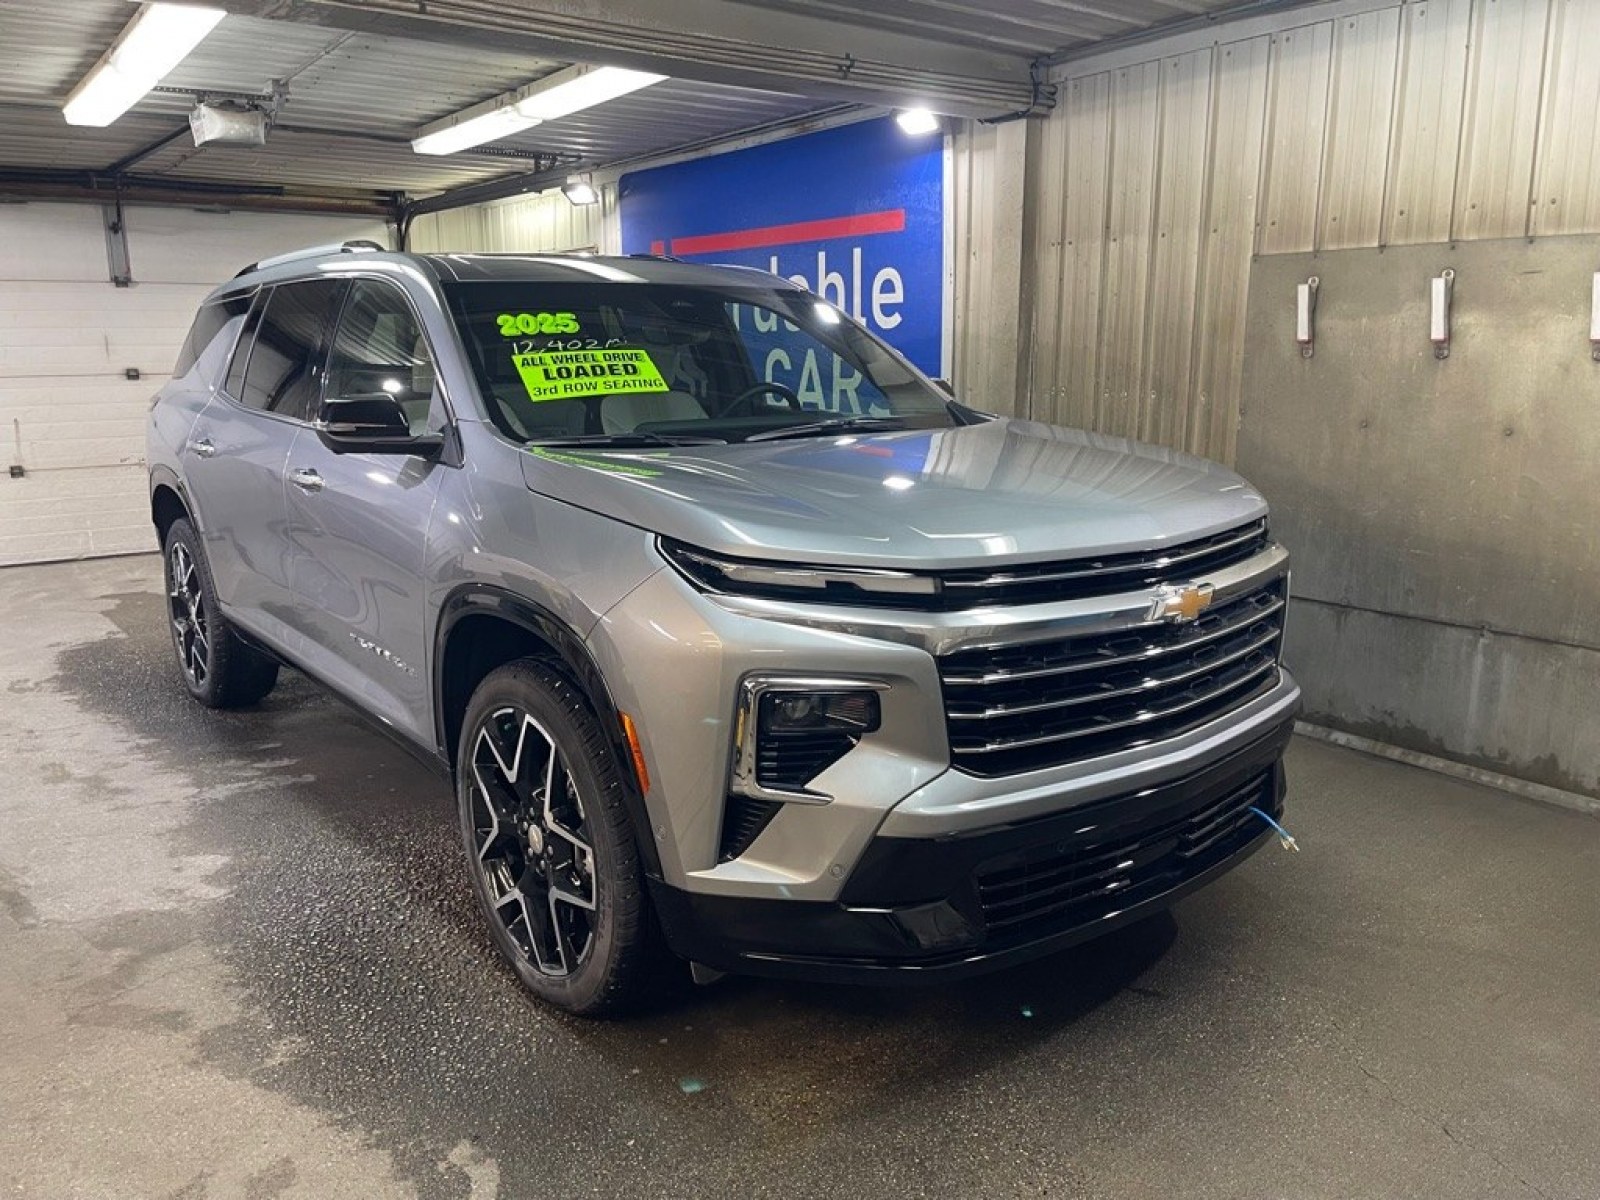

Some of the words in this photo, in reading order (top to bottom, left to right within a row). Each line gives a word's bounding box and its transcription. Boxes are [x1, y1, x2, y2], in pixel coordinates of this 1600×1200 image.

[497, 312, 580, 336] 2025
[521, 356, 546, 367] ALL
[552, 353, 600, 364] WHEEL
[603, 352, 643, 362] DRIVE
[543, 363, 638, 380] LOADED
[533, 386, 558, 397] 3rd
[563, 382, 598, 393] ROW
[603, 377, 663, 390] SEATING
[765, 348, 891, 418] CAR
